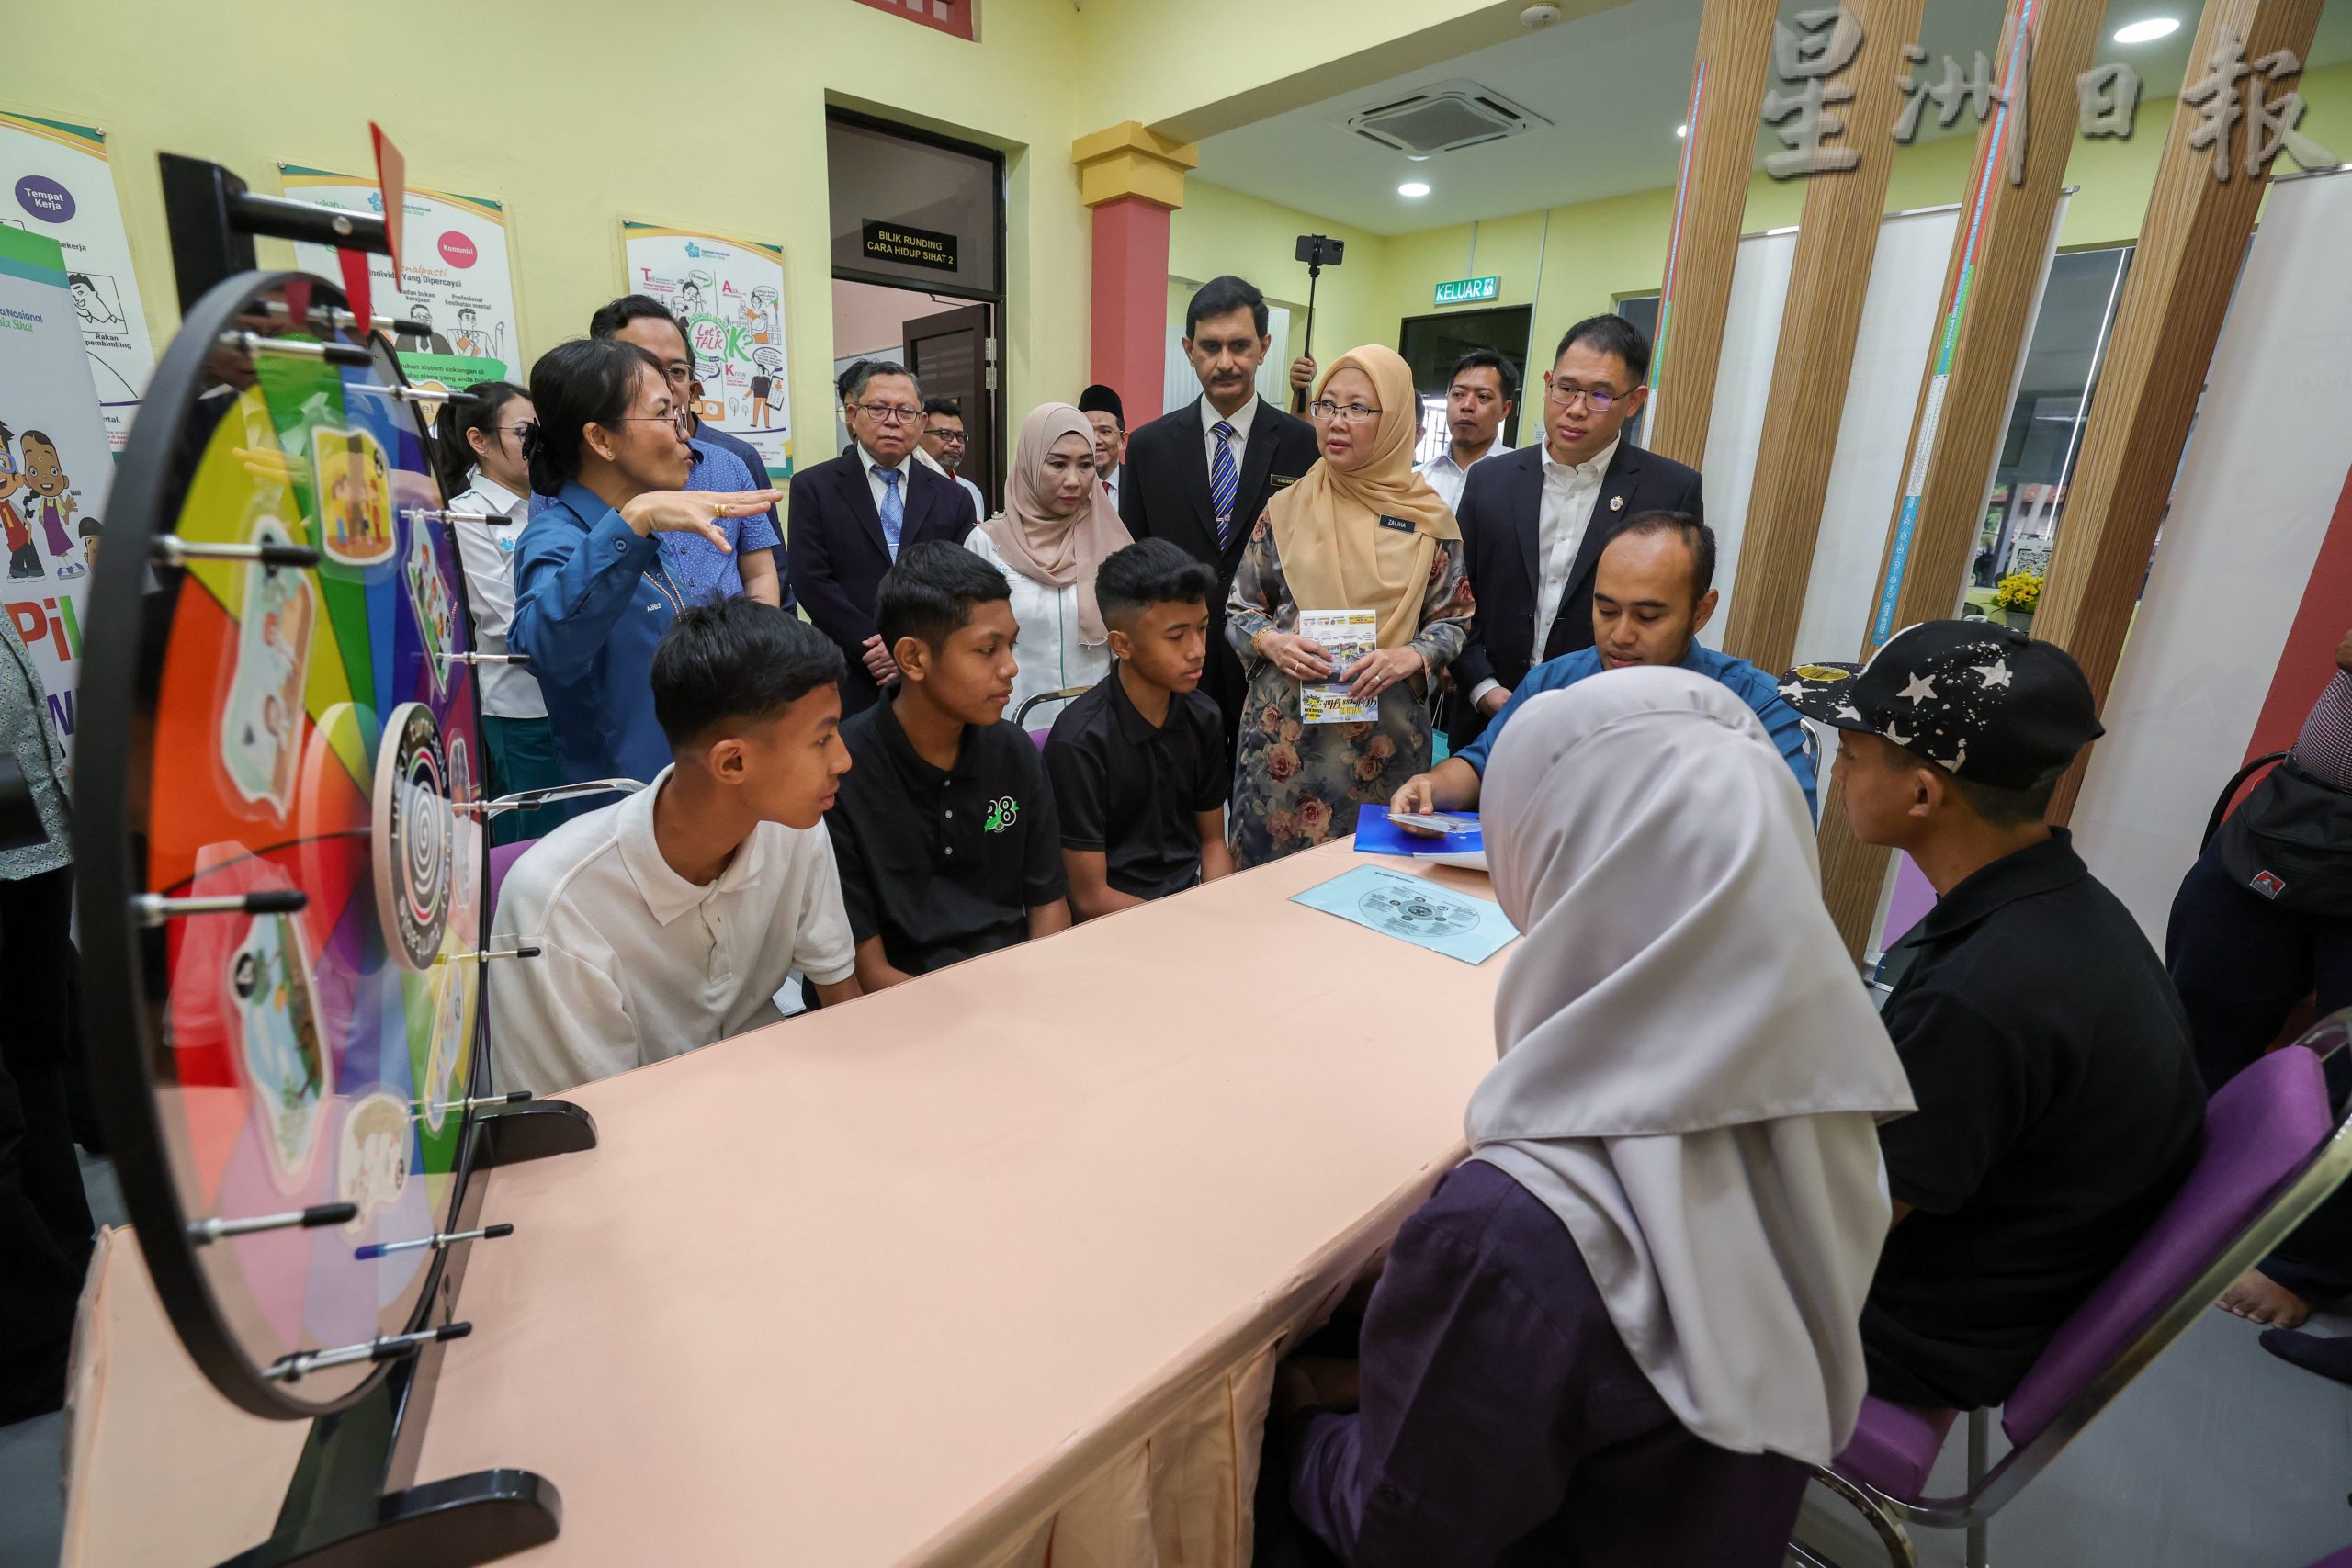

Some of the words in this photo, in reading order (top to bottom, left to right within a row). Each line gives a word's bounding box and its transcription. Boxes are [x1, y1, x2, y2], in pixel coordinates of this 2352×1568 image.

[24, 187, 64, 202] Tempat
[35, 198, 62, 210] Kerja
[878, 231, 901, 243] BILIK
[903, 235, 943, 251] RUNDING
[443, 243, 474, 255] Komuniti
[867, 241, 893, 254] CARA
[894, 245, 921, 258] HIDUP
[922, 251, 947, 264] SIHAT
[369, 269, 397, 279] Individ
[402, 273, 422, 284] Yang
[423, 276, 462, 288] Dipercayai
[1436, 279, 1482, 301] KELUAR
[451, 294, 483, 302] Profesional
[6, 309, 43, 323] Nasional
[12, 319, 34, 332] Sihat
[85, 340, 132, 350] pembimbing
[695, 336, 724, 349] TALK
[1387, 519, 1407, 528] ZALIHA
